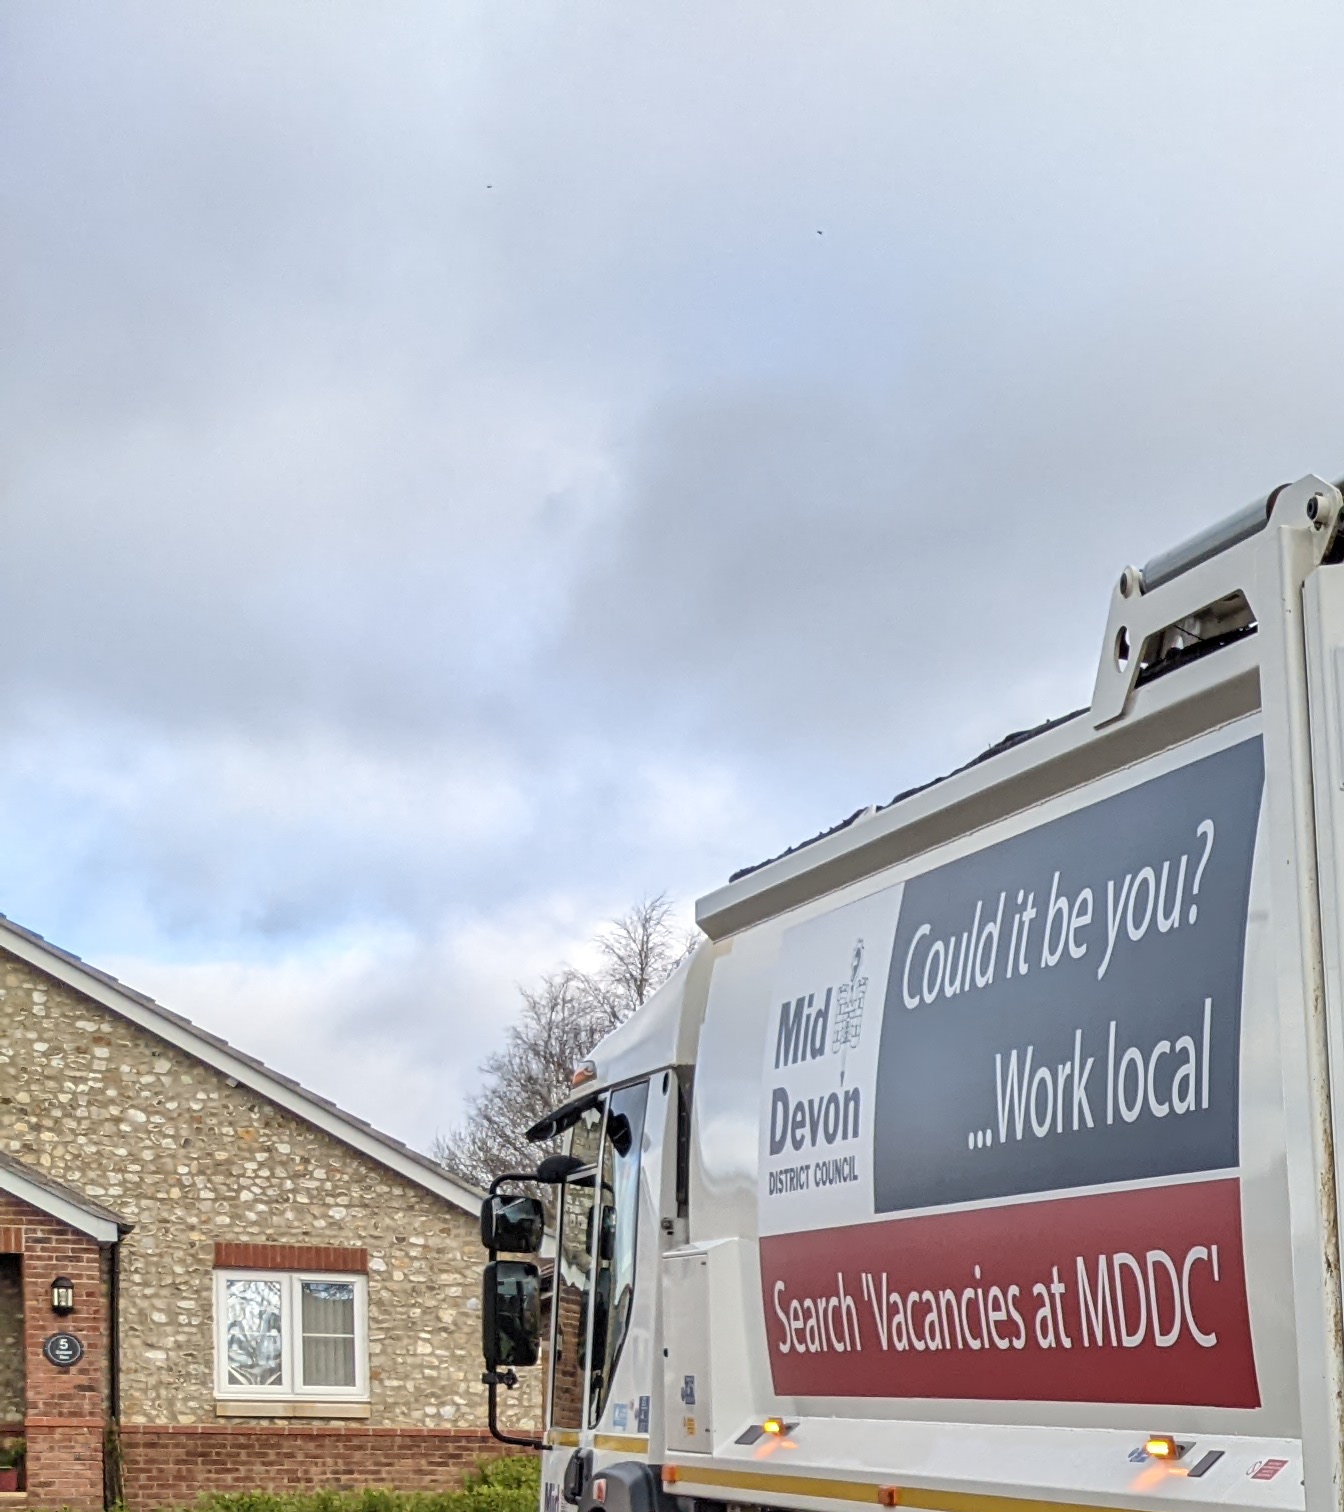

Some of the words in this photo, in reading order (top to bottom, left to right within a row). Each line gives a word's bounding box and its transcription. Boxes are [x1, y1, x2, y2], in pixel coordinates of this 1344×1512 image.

[902, 891, 1006, 1010] Could
[1006, 889, 1037, 979] it
[1040, 871, 1094, 968] be
[1097, 819, 1215, 981] you?
[774, 986, 833, 1070] Mid
[968, 1029, 1095, 1150] ...Work
[1106, 997, 1212, 1126] local
[769, 1086, 861, 1156] Devon
[769, 1164, 811, 1196] DISTRICT
[814, 1155, 859, 1188] COUNCIL
[773, 1272, 862, 1353] Search
[861, 1265, 1027, 1352] 'Vacancies
[1032, 1266, 1072, 1349] at
[1075, 1245, 1219, 1348] MDDC'
[59, 1338, 69, 1350] 5
